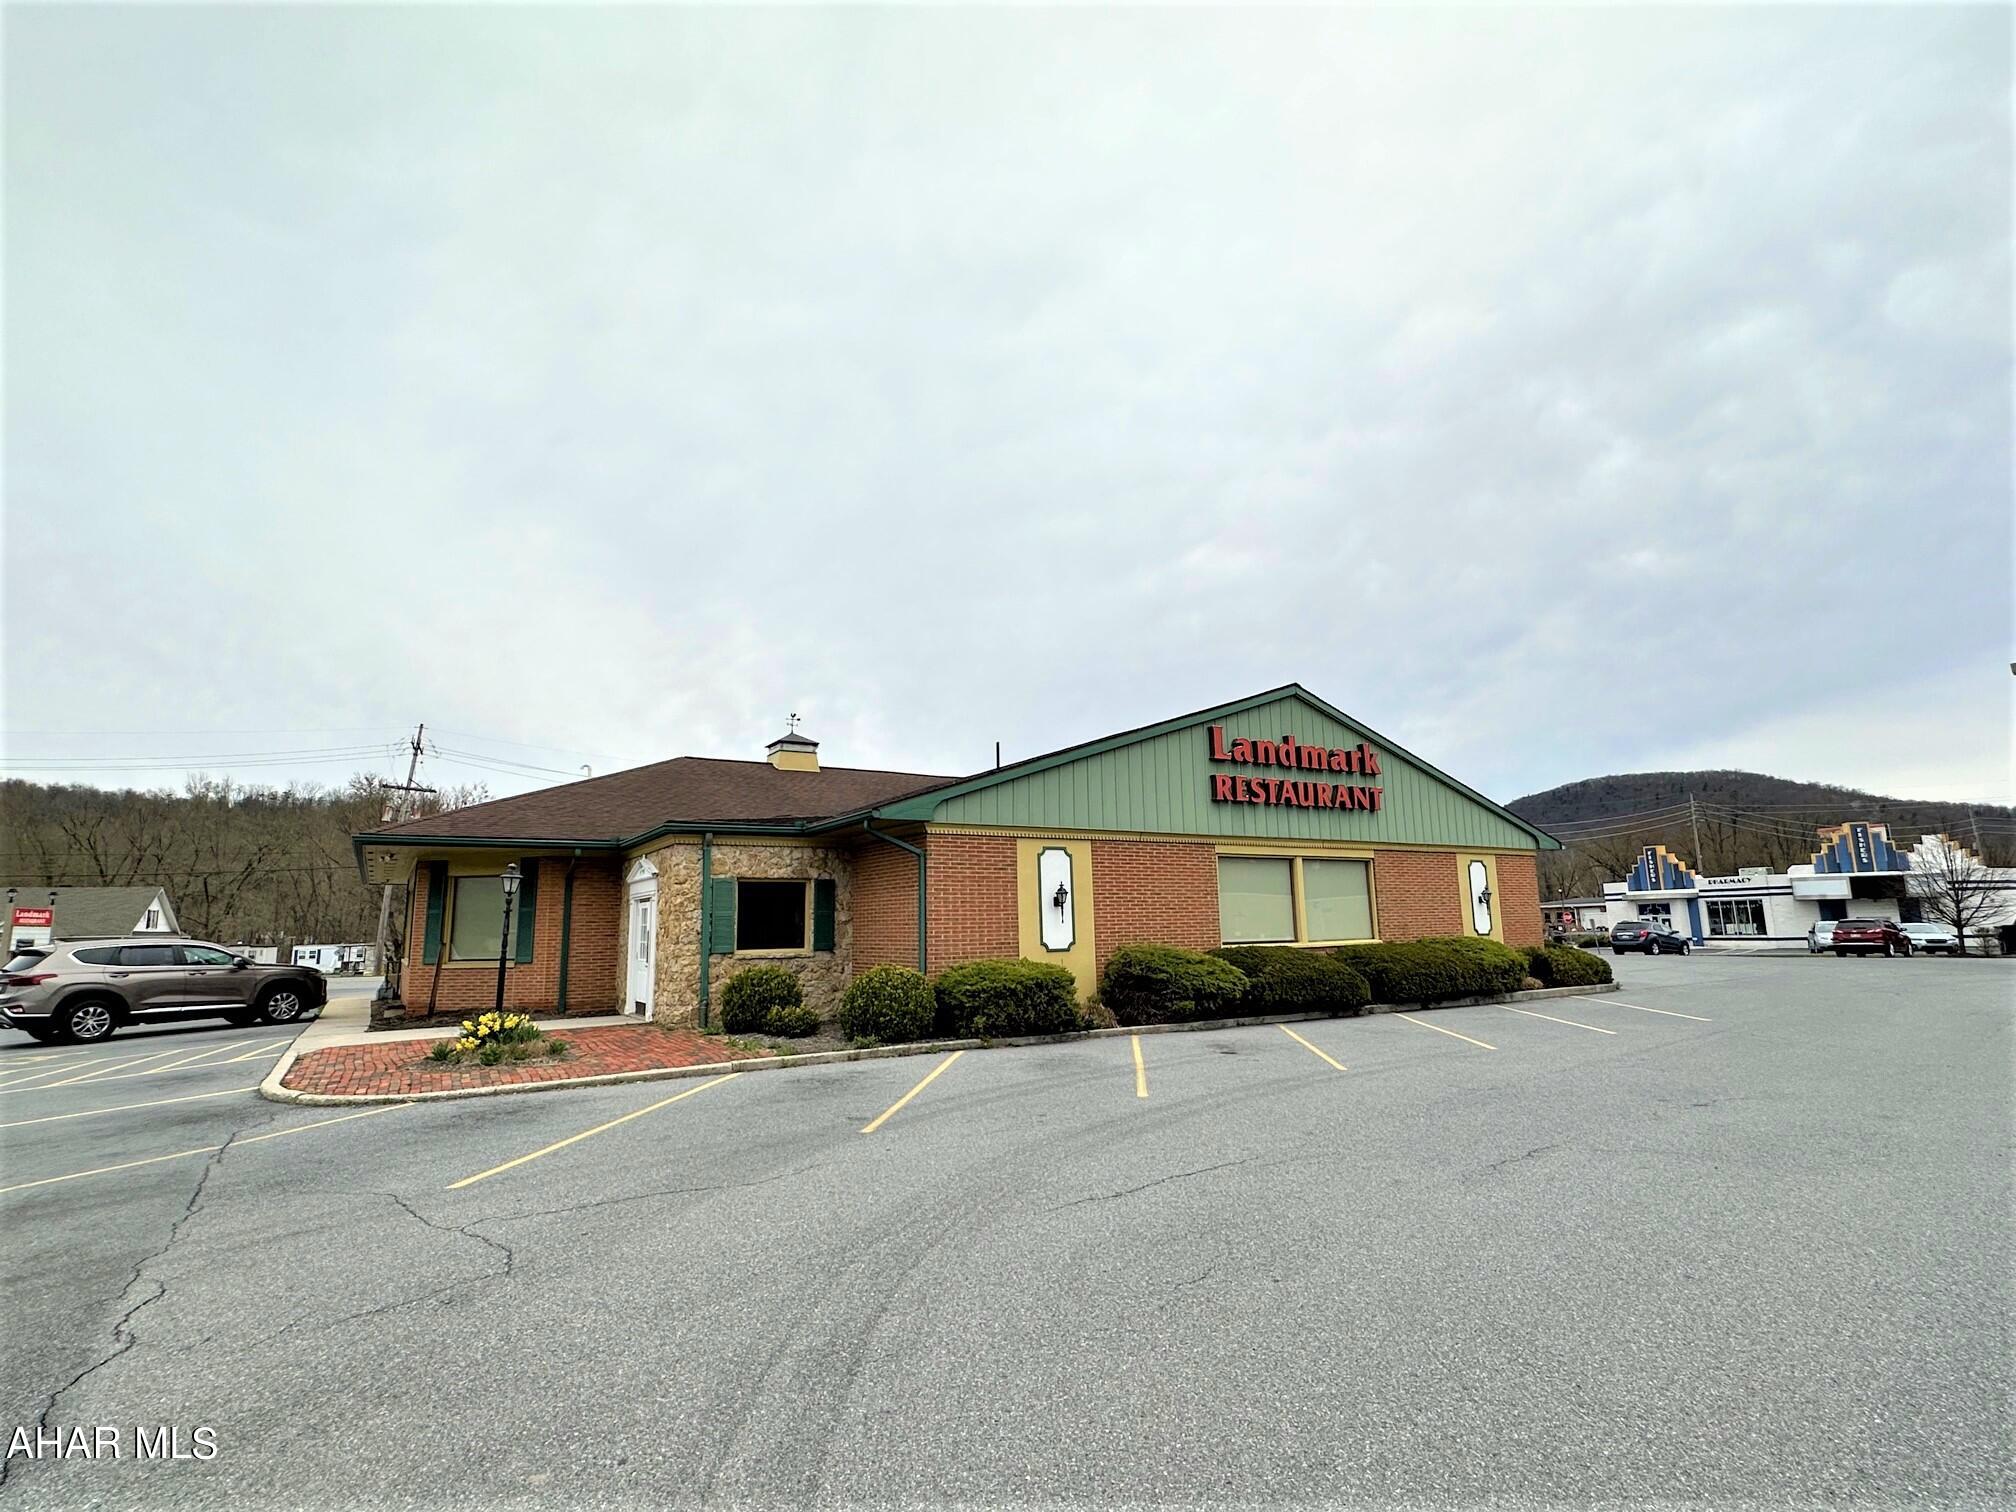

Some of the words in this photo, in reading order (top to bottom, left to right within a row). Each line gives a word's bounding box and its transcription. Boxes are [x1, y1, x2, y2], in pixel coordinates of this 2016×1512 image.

[1208, 725, 1382, 775] Landmark
[1210, 774, 1383, 811] RESTAURANT
[1707, 877, 1753, 885] PHARMACY
